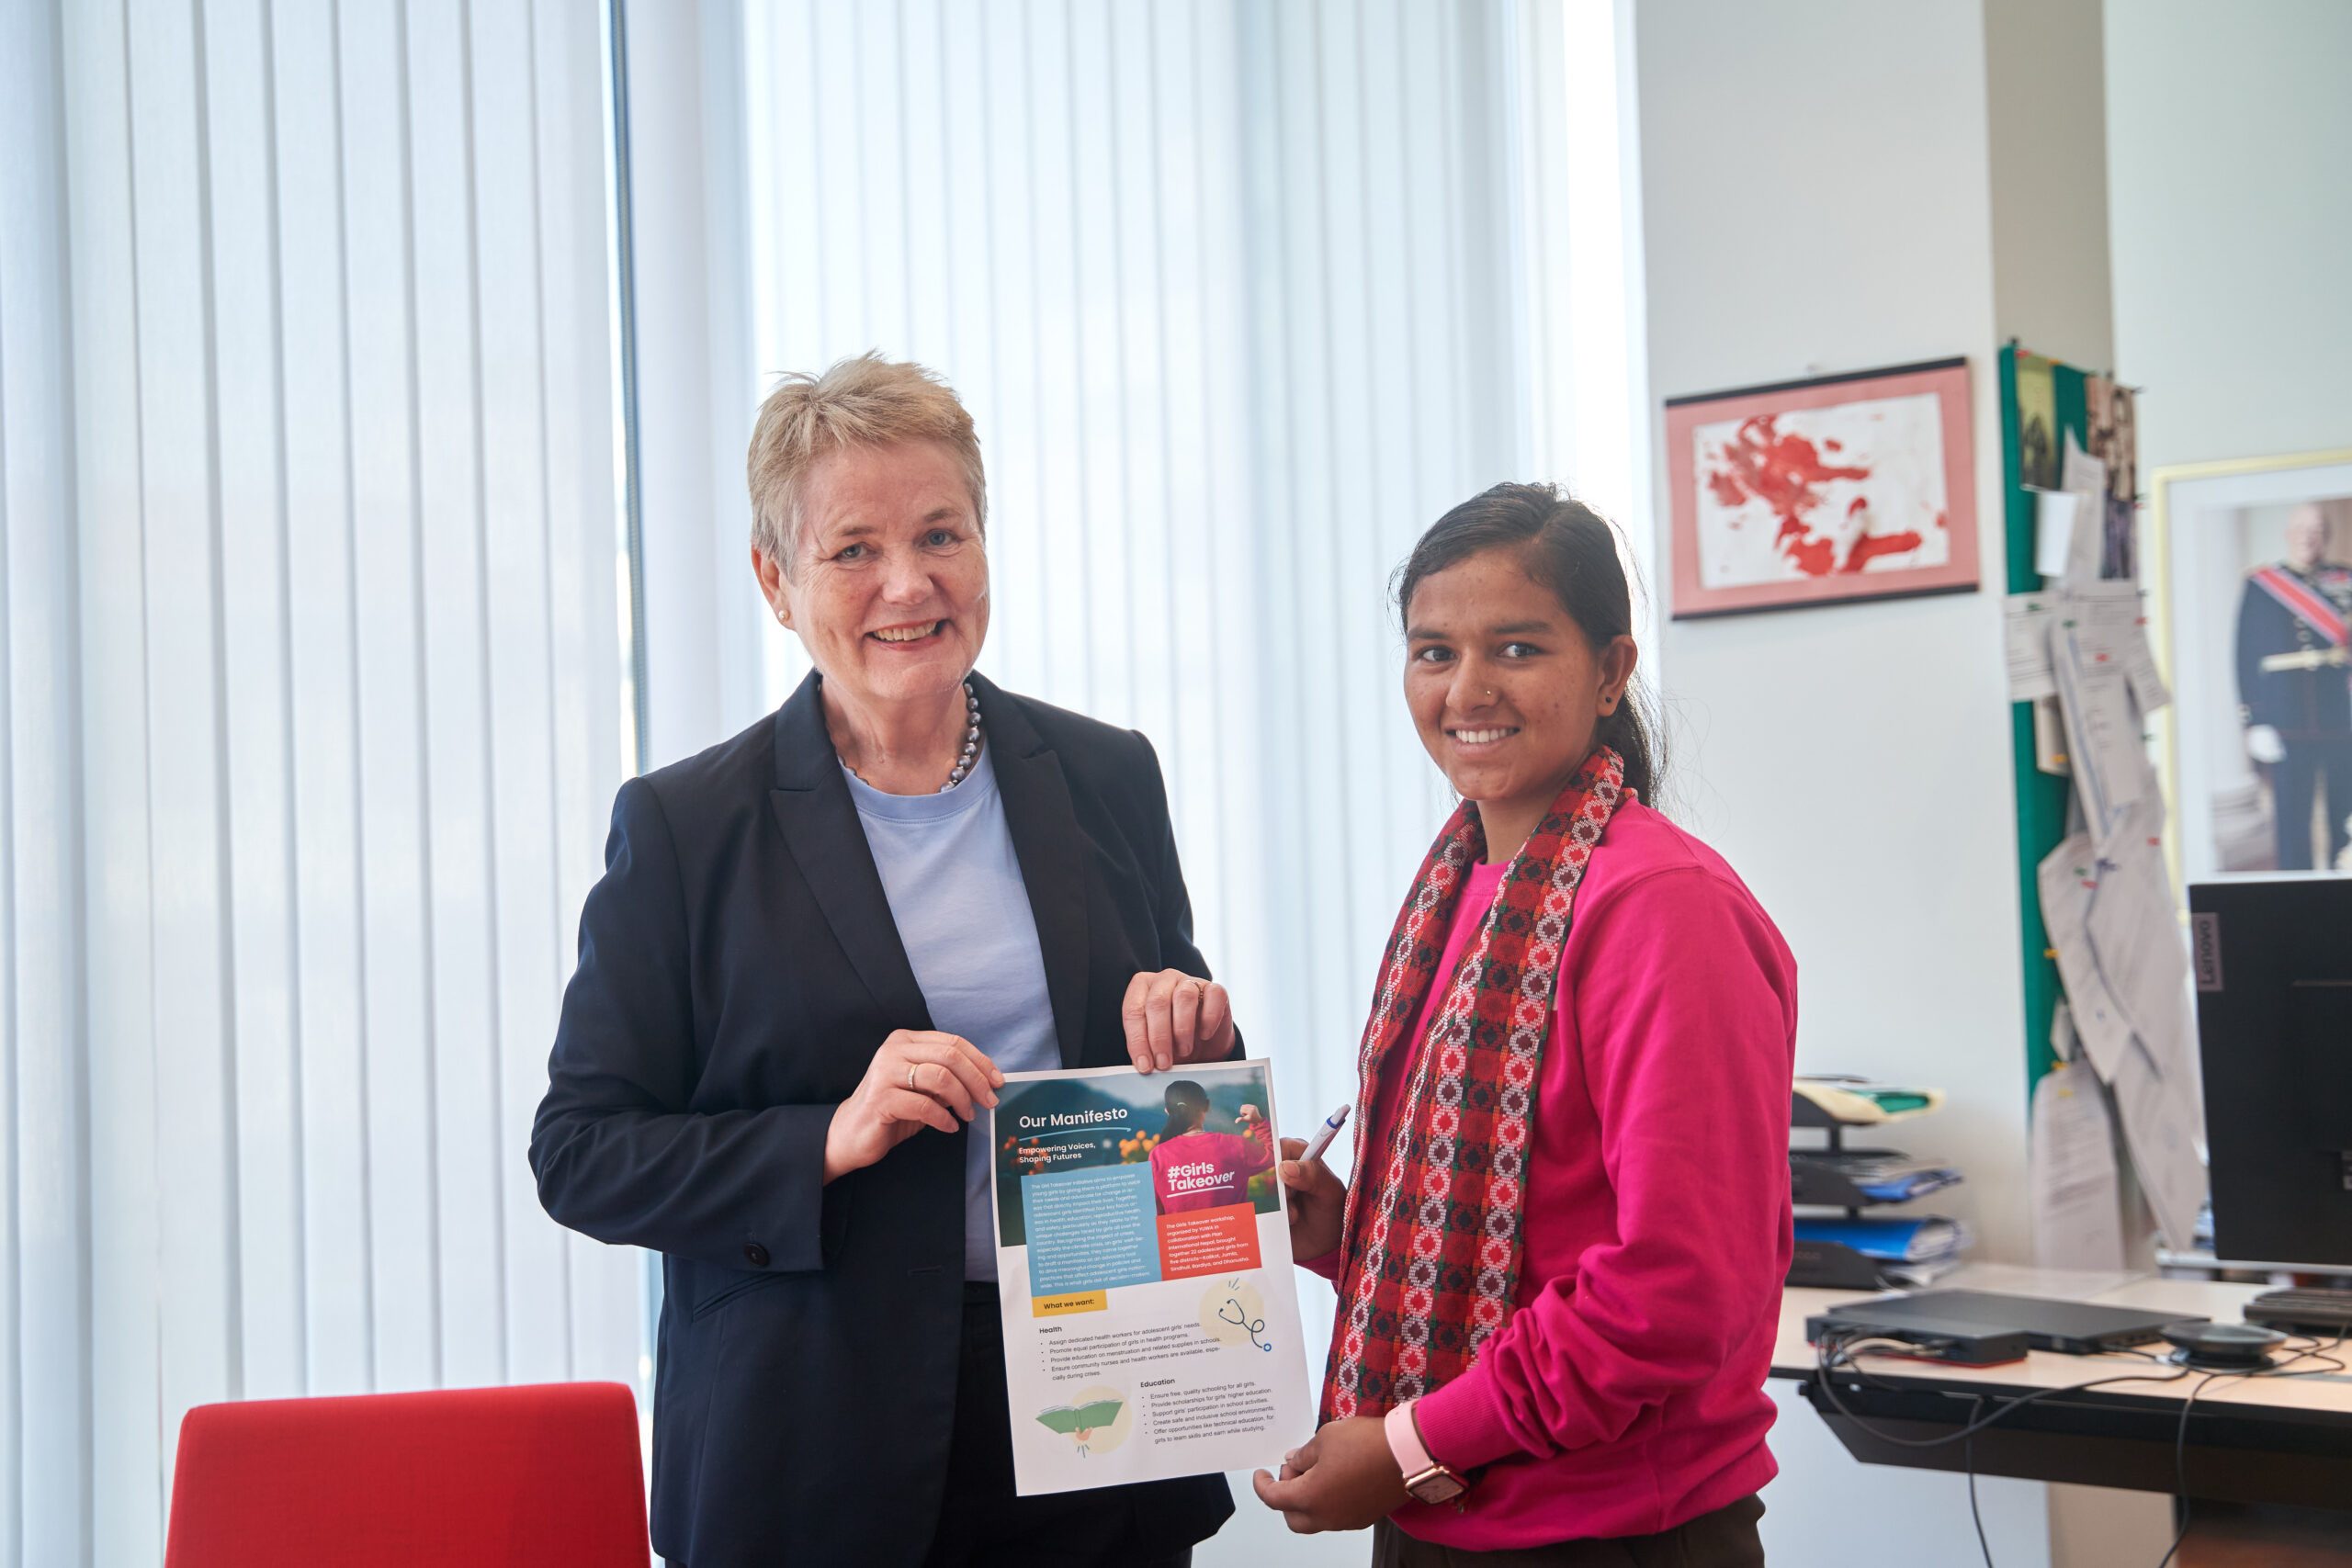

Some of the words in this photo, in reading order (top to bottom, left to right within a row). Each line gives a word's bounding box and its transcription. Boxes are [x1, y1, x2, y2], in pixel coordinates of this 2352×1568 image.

[2199, 920, 2215, 985] Lenovo
[1019, 1115, 1046, 1128] Our
[1050, 1108, 1127, 1126] Manifesto
[1019, 1145, 1067, 1155] Empowering
[1068, 1142, 1096, 1150] Voices,
[1019, 1156, 1051, 1165] Shaping
[1053, 1152, 1082, 1161] Futures
[1168, 1162, 1215, 1179] #Girls
[1168, 1170, 1235, 1191] Takeover
[1044, 1302, 1063, 1310] What
[1039, 1325, 1062, 1334] Health
[1141, 1325, 1170, 1334] adolescent
[1089, 1342, 1121, 1350] participation
[1106, 1348, 1141, 1356] menstruation
[1071, 1361, 1100, 1370] community
[1140, 1378, 1175, 1388] Education
[1187, 1404, 1219, 1413] participation
[1168, 1425, 1203, 1433] opportunities
